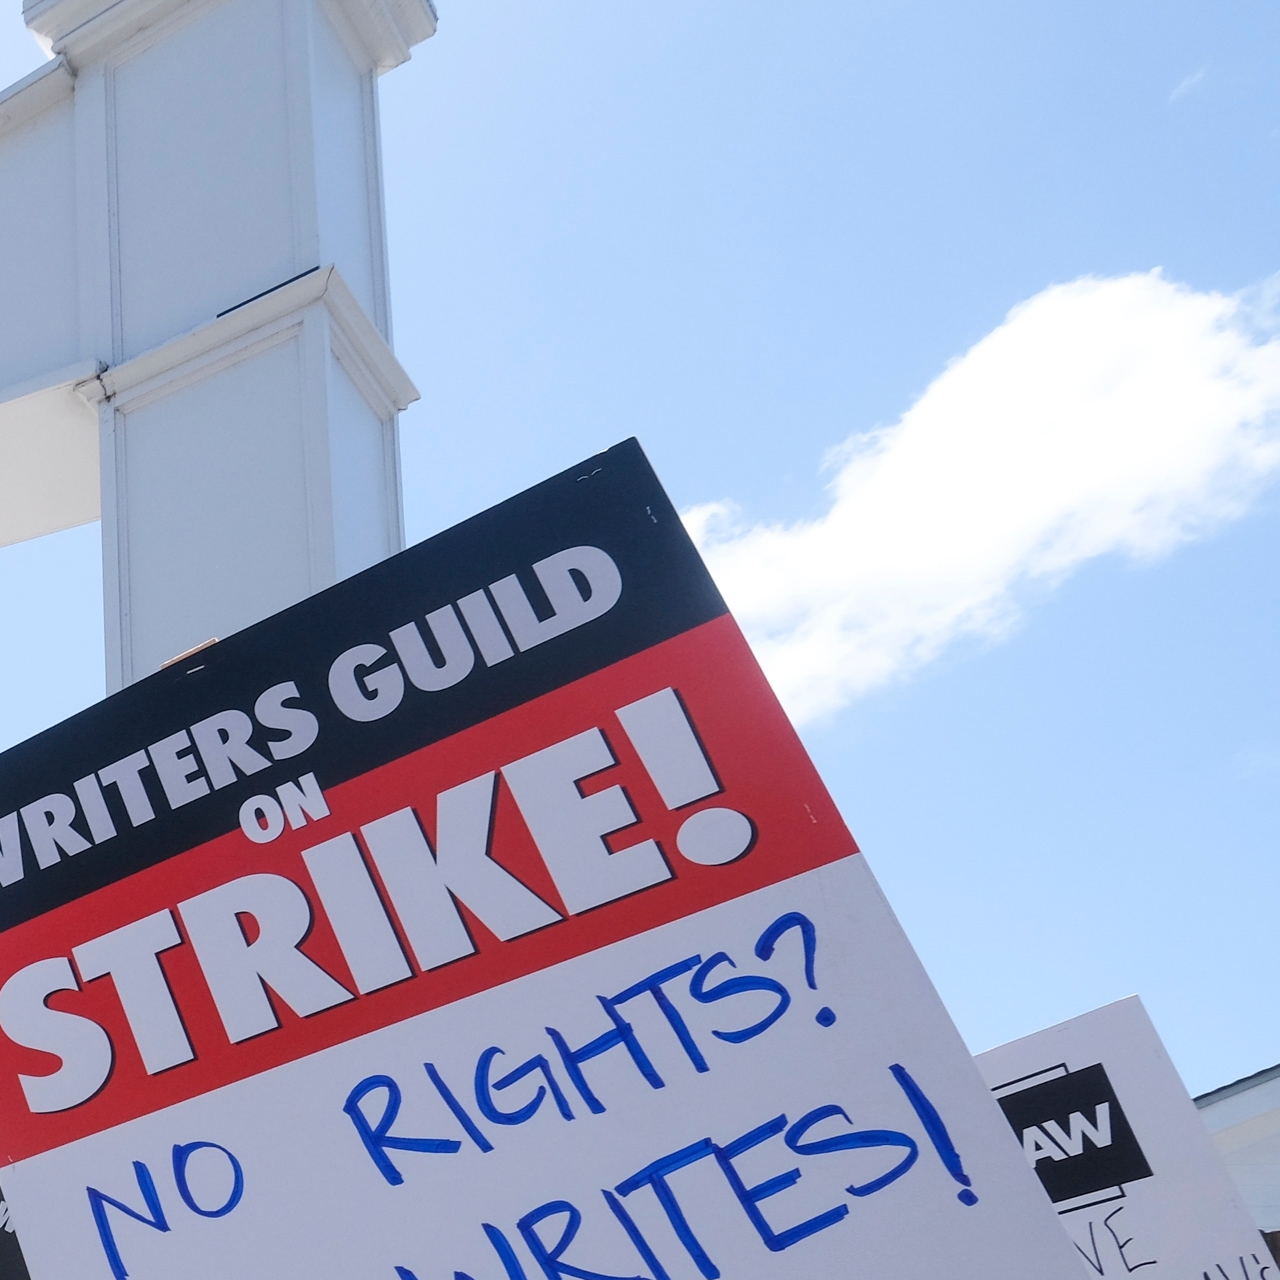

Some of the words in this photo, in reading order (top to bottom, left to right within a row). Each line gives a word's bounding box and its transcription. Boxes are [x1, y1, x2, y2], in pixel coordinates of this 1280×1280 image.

[328, 544, 624, 724] GUILD
[238, 771, 332, 845] ON
[342, 911, 839, 1187] RIGHTS?
[1021, 1101, 1113, 1168] AW
[1072, 1206, 1158, 1277] VE
